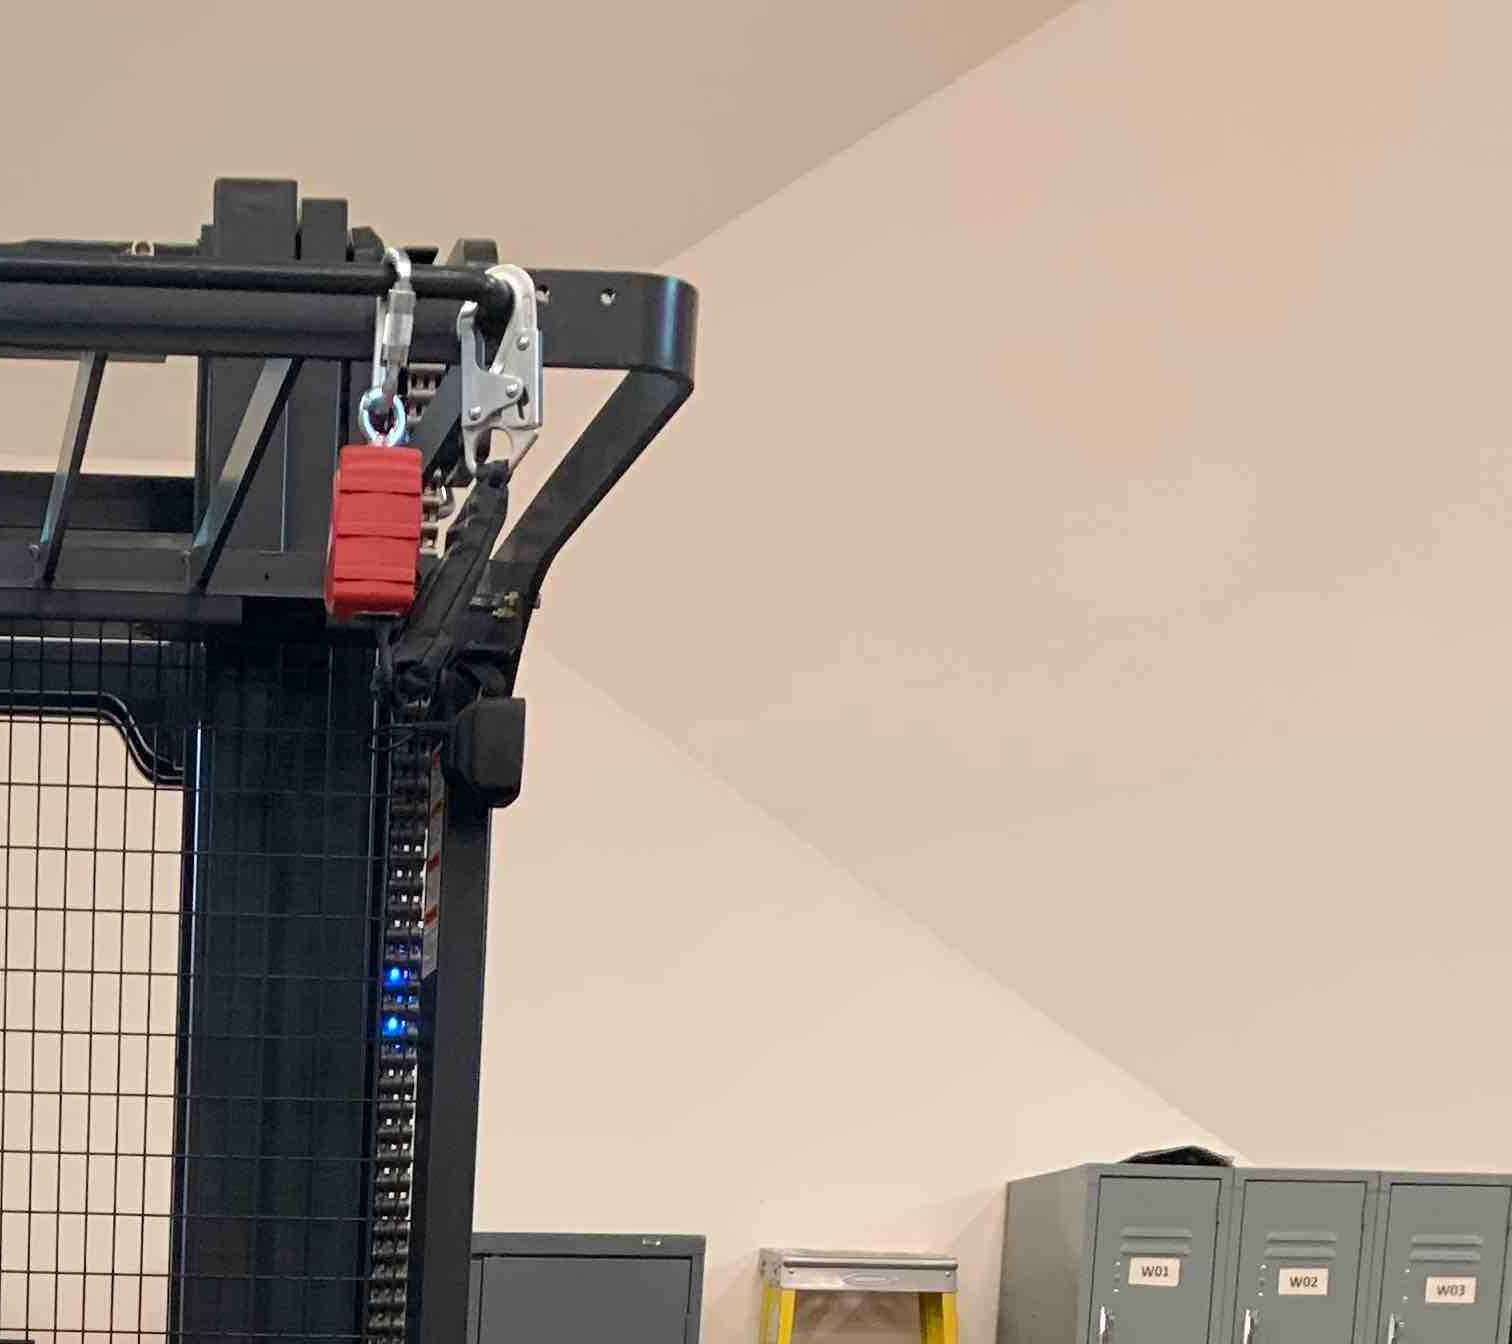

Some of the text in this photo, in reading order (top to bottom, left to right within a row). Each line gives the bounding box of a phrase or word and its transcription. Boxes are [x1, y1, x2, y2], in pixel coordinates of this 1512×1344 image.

[1141, 1265, 1169, 1278] W01
[1289, 1276, 1318, 1288] W02
[1437, 1284, 1466, 1297] W03
